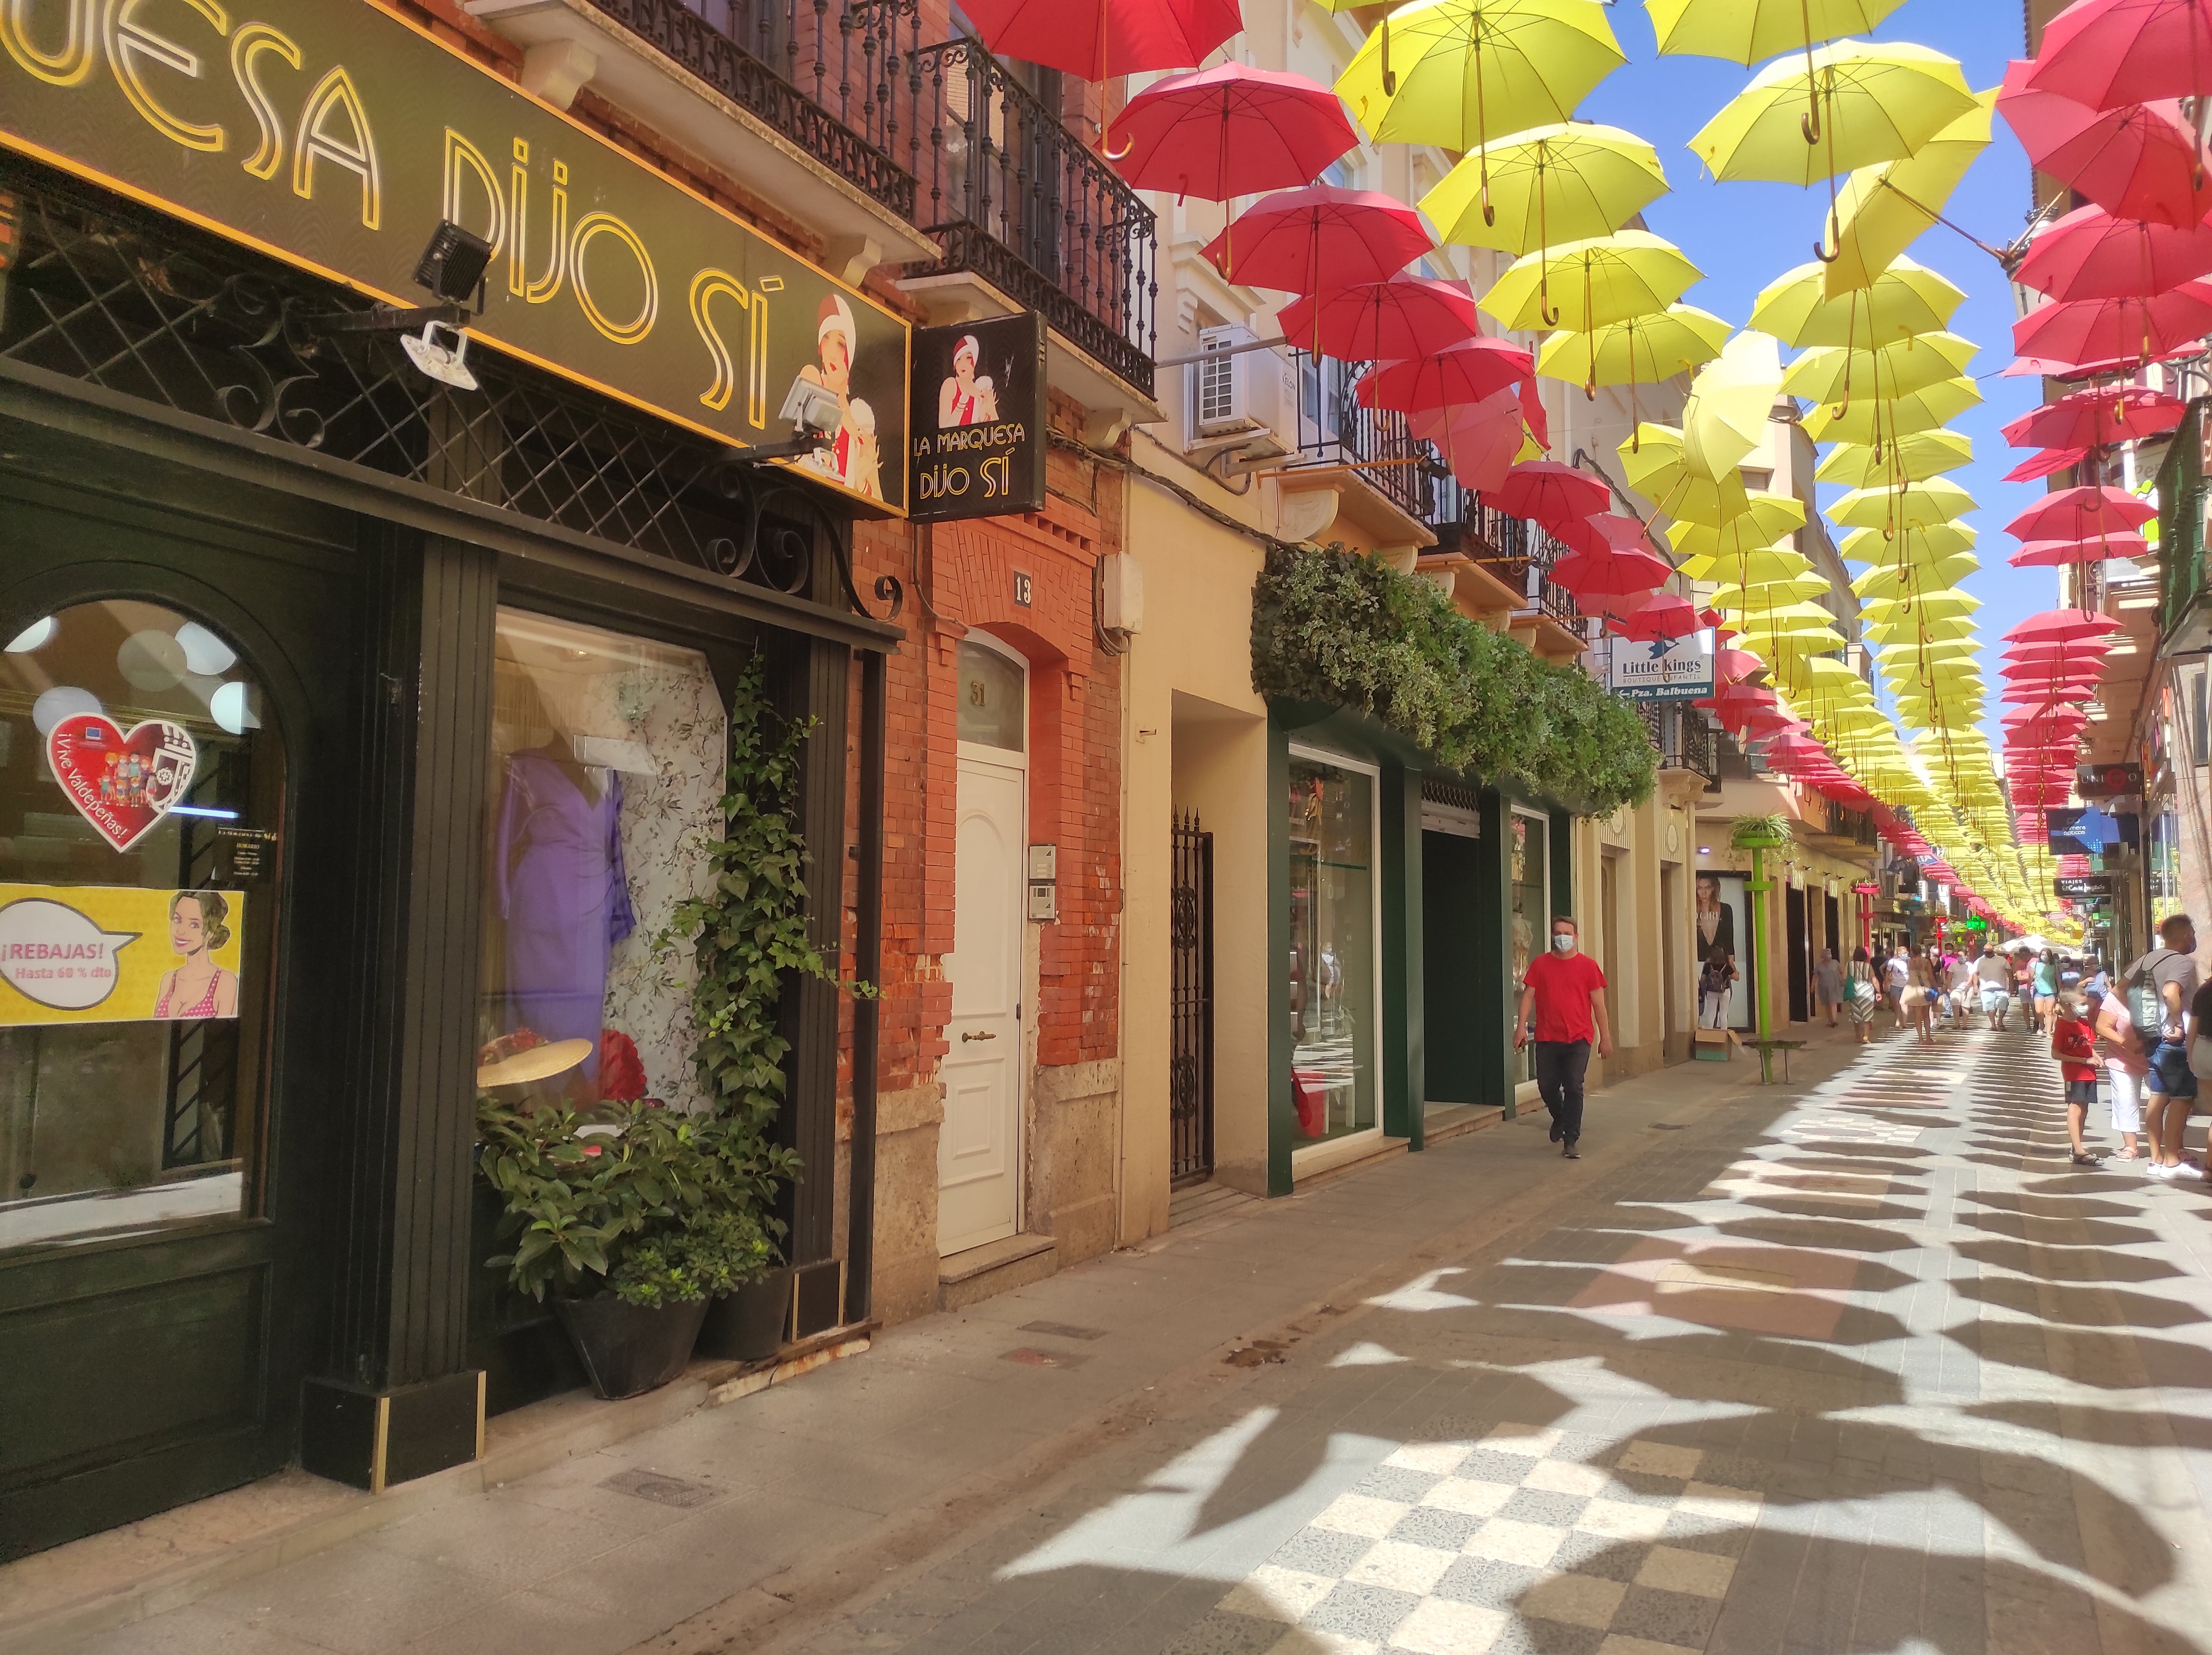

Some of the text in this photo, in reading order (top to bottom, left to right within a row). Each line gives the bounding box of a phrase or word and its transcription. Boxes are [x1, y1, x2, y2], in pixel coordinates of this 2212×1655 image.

[688, 267, 785, 429] SÍ
[1282, 373, 1296, 391] KELON
[913, 422, 1025, 457] LA MARQUESA
[980, 447, 1016, 498] SÍ
[1016, 576, 1031, 604] 13
[1623, 661, 1659, 674] Little
[1623, 675, 1660, 684] BOUTIQUE
[1631, 686, 1708, 697] Pza. Balbuena
[57, 733, 129, 839] ¡Vive Valdepeñas!
[1, 943, 104, 961] ¡REBAJAS!
[15, 967, 112, 979] Hasta 60 % dto
